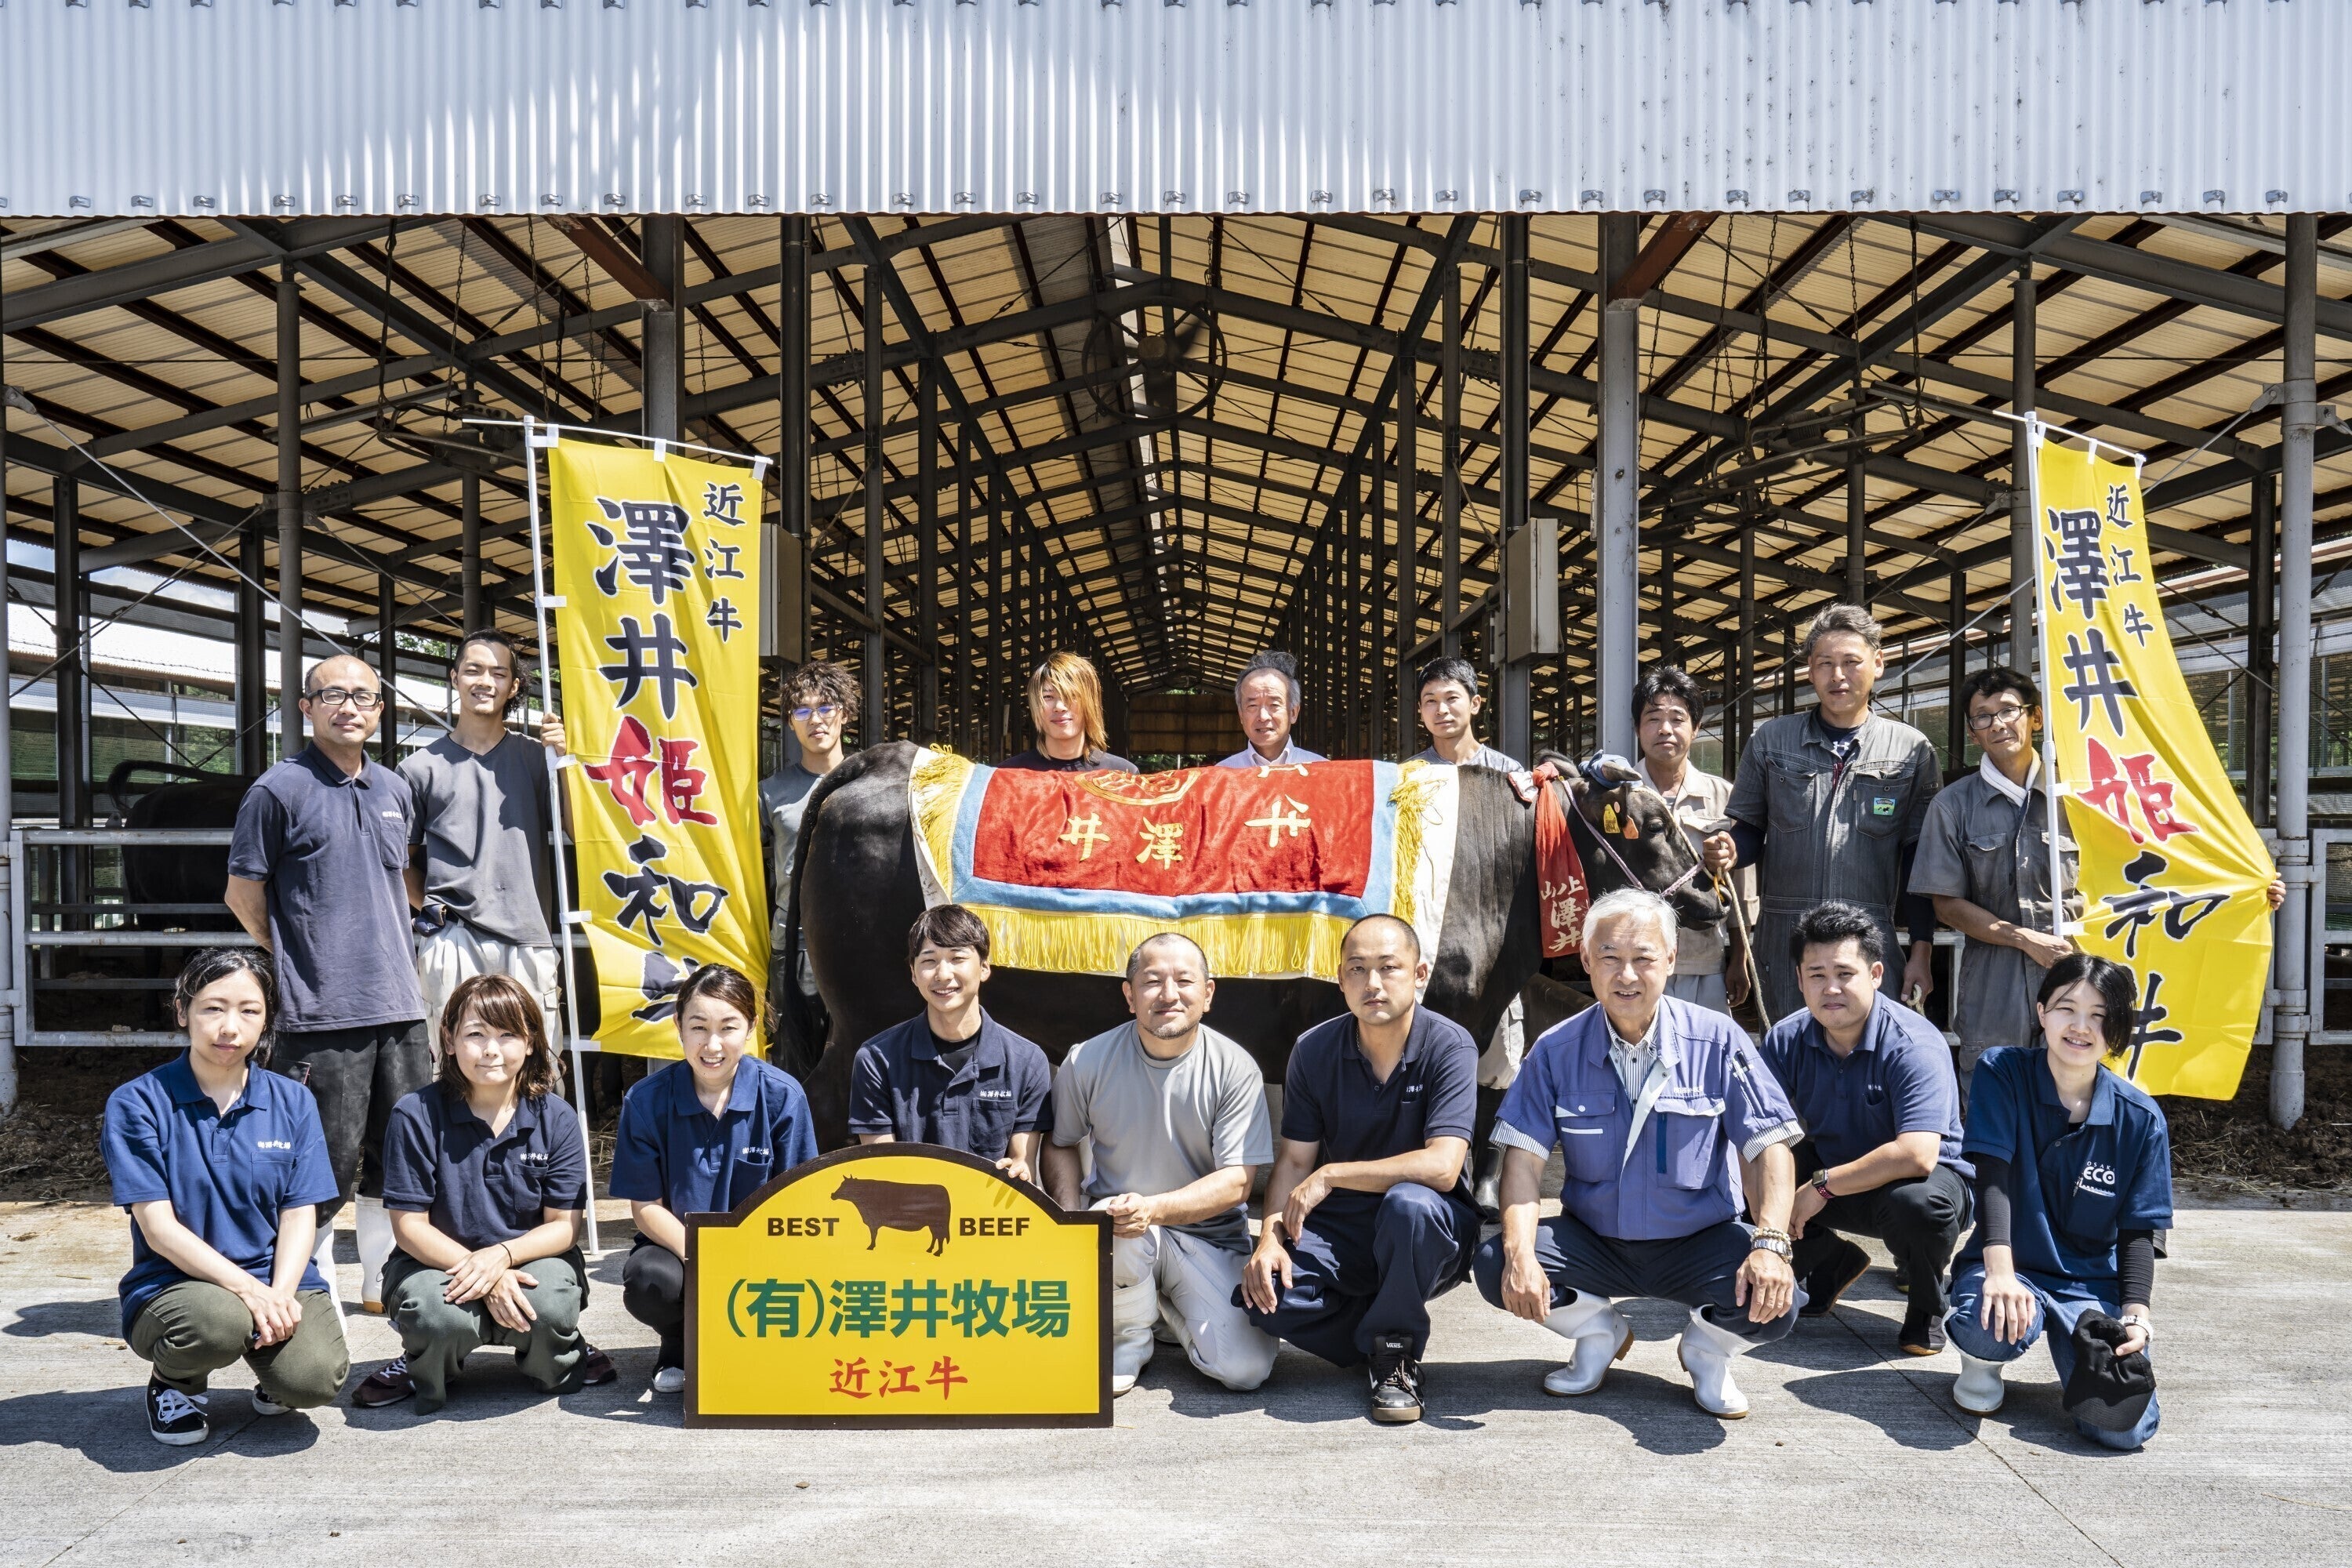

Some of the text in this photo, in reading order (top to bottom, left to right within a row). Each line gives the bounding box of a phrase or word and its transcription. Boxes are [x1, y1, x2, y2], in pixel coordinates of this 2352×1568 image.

[702, 482, 746, 641] 近江牛
[2106, 485, 2154, 647] 近江牛
[767, 1217, 1030, 1237] BEST BEEF
[727, 1278, 1072, 1339] (有)澤井牧場
[829, 1355, 969, 1400] 近江牛
